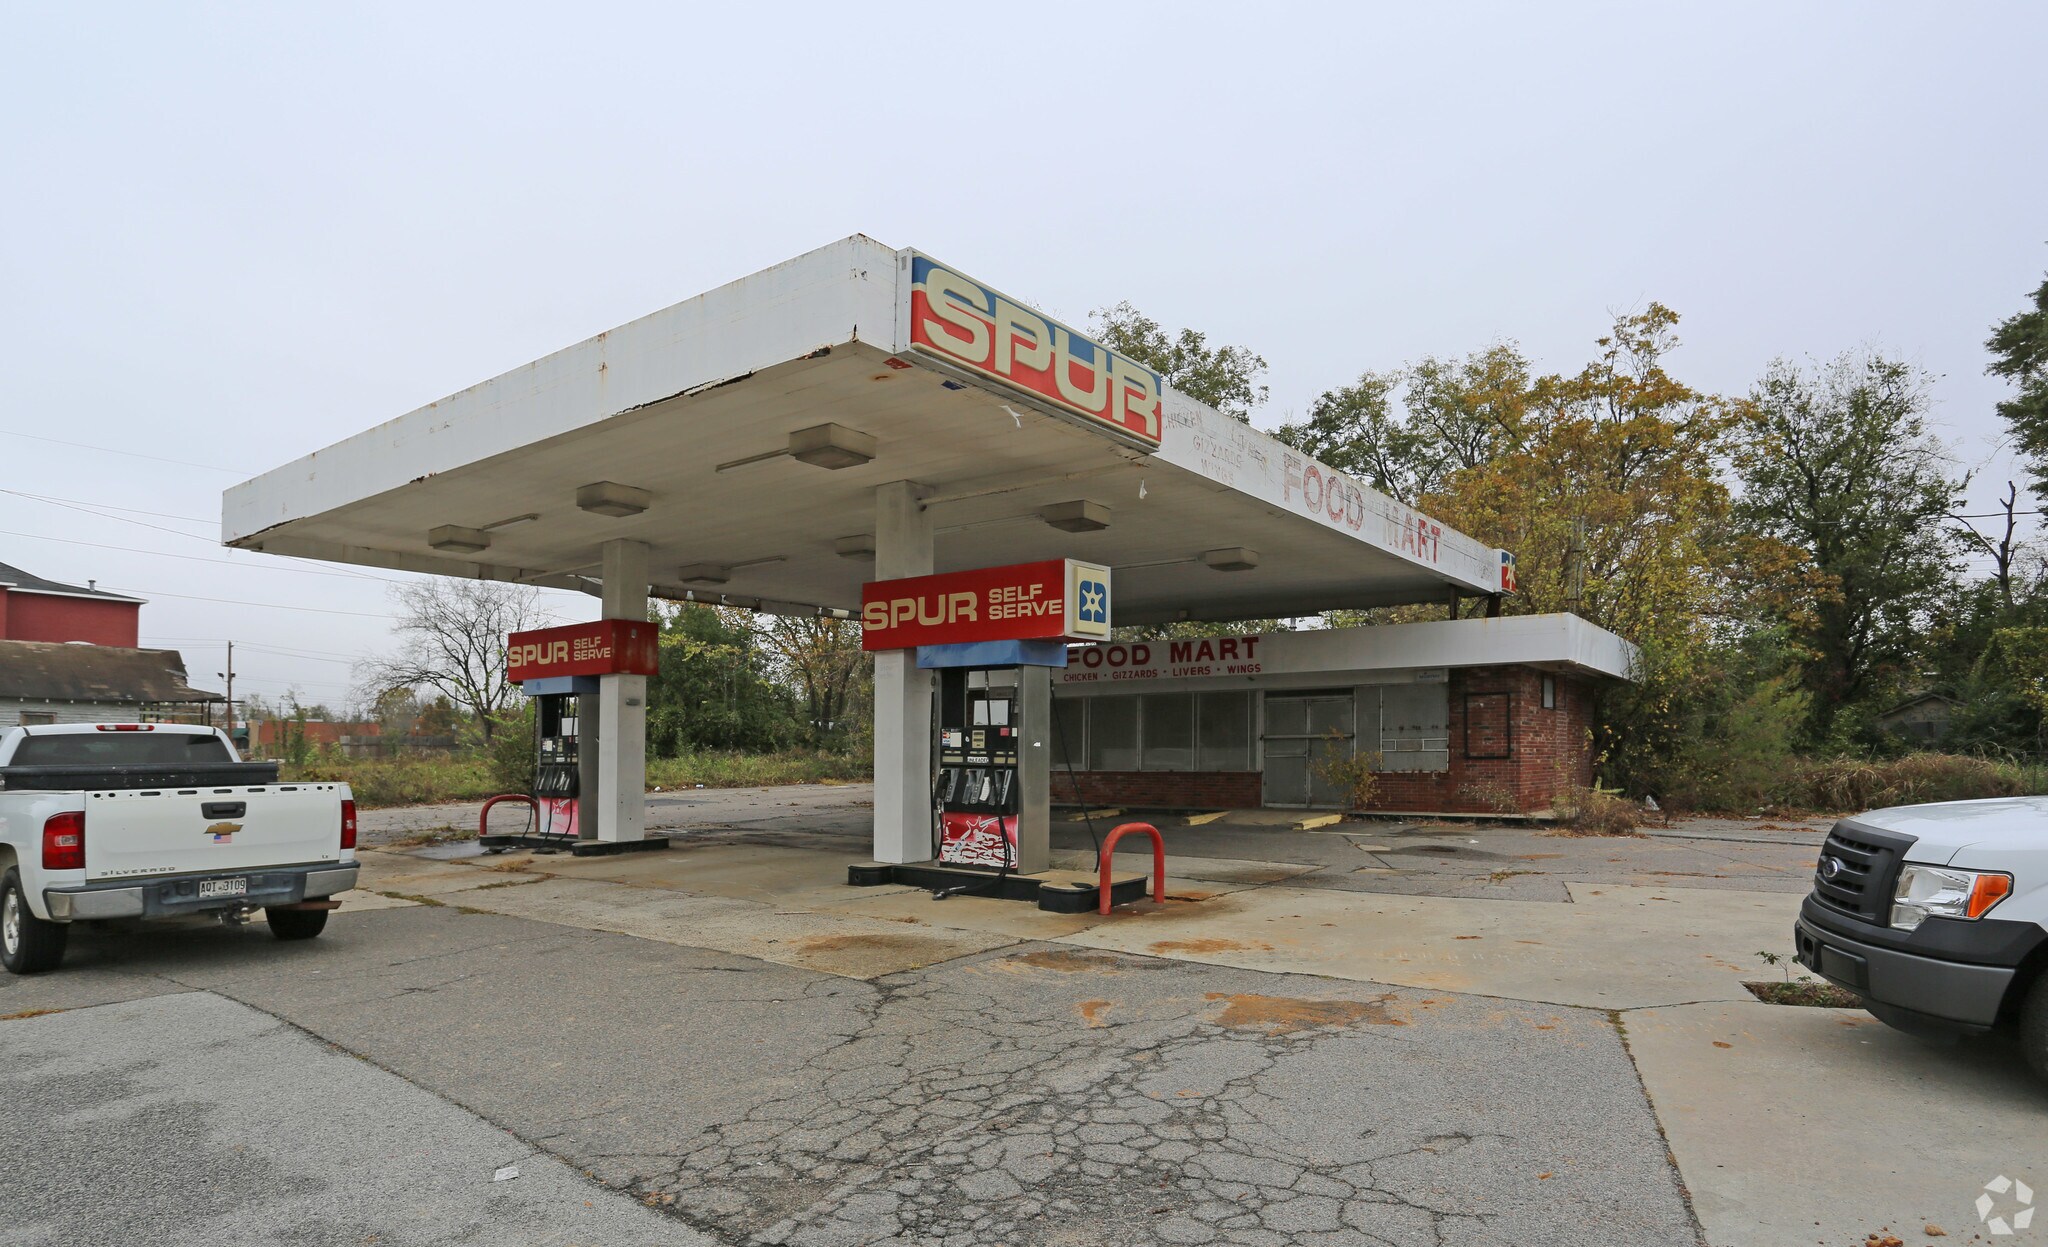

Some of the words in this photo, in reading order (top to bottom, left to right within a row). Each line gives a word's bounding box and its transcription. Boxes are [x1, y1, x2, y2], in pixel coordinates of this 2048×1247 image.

[923, 268, 1158, 438] SPUR
[1283, 452, 1364, 532] FOOD
[1382, 500, 1442, 564] MART
[988, 583, 1043, 603] SELF
[863, 591, 978, 631] SPUR
[988, 599, 1063, 620] SERVE
[573, 636, 602, 650] SELF
[1169, 636, 1260, 664] MART
[508, 640, 569, 668] SPUR
[573, 647, 611, 661] SERVE
[1063, 672, 1098, 682] CHICKEN
[1112, 669, 1158, 680] GIZZARDS
[1172, 666, 1211, 677] LIVERS
[1227, 663, 1261, 674] WINGS
[101, 866, 176, 876] SILVERADO
[223, 879, 246, 891] 3109
